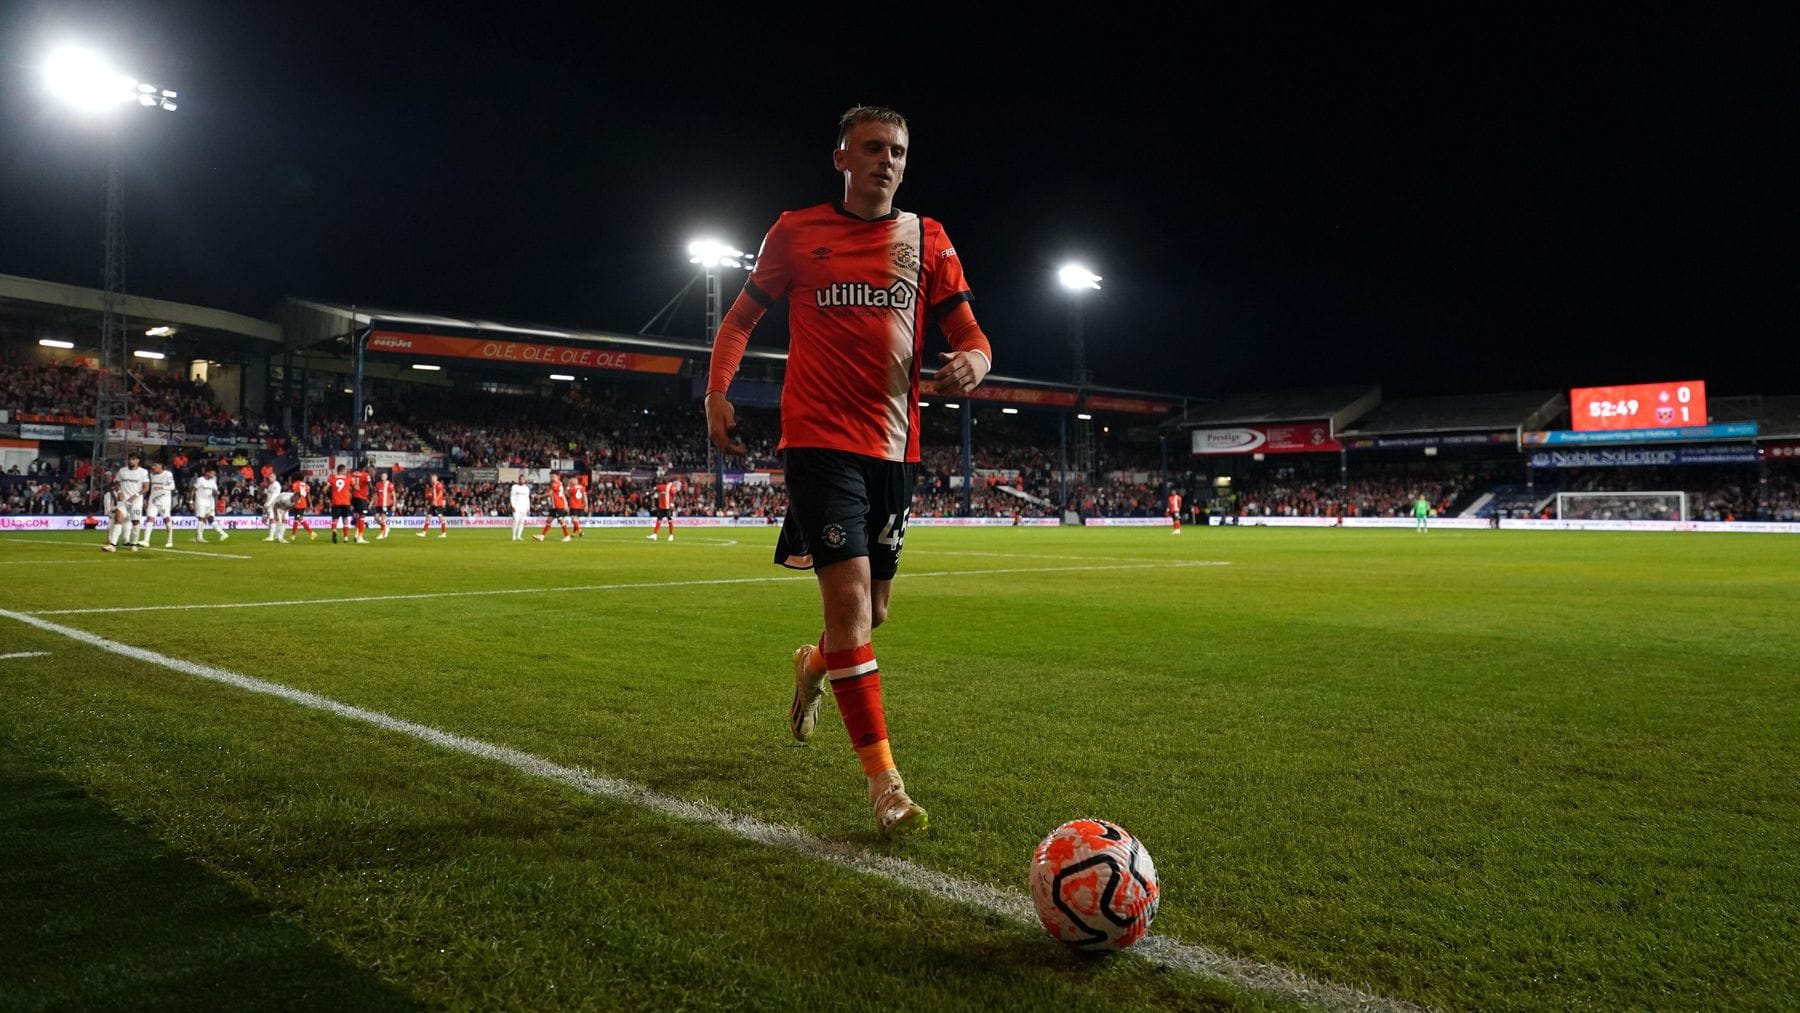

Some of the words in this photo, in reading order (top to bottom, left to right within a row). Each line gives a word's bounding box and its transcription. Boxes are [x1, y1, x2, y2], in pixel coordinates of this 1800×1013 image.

[816, 283, 889, 308] utilita
[374, 338, 413, 349] easyJet
[1589, 400, 1639, 418] 52:49
[1677, 386, 1691, 403] 0
[1680, 407, 1690, 422] 1
[1207, 433, 1241, 442] Prestige
[1552, 450, 1600, 464] Noble
[1602, 448, 1677, 462] Solicitors
[335, 479, 345, 492] 9
[576, 488, 583, 499] 6
